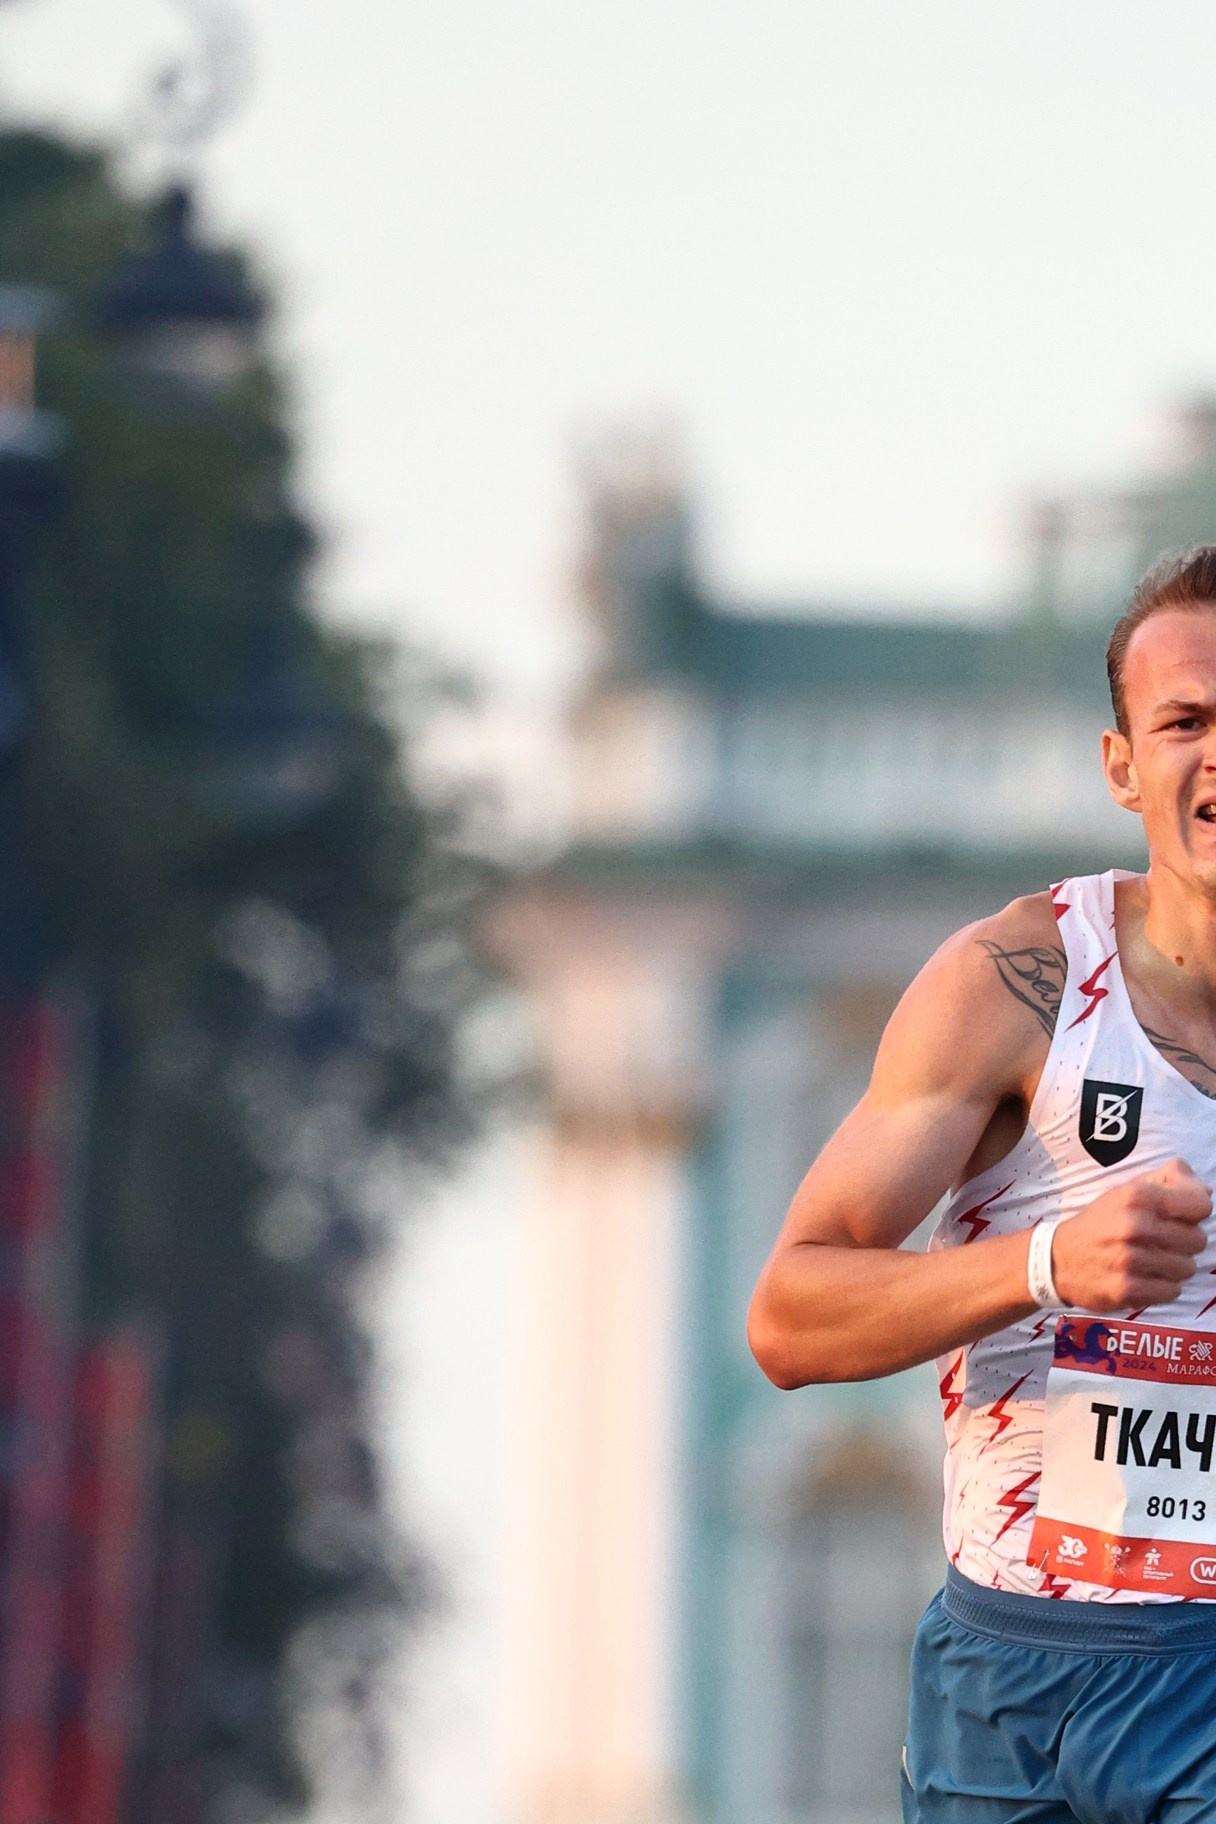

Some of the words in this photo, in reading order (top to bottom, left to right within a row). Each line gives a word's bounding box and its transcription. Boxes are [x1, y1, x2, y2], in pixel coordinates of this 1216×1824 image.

[1106, 1328, 1184, 1361] БЕЛЫЕ
[1122, 1358, 1157, 1372] 2024
[1146, 1496, 1206, 1522] 8013
